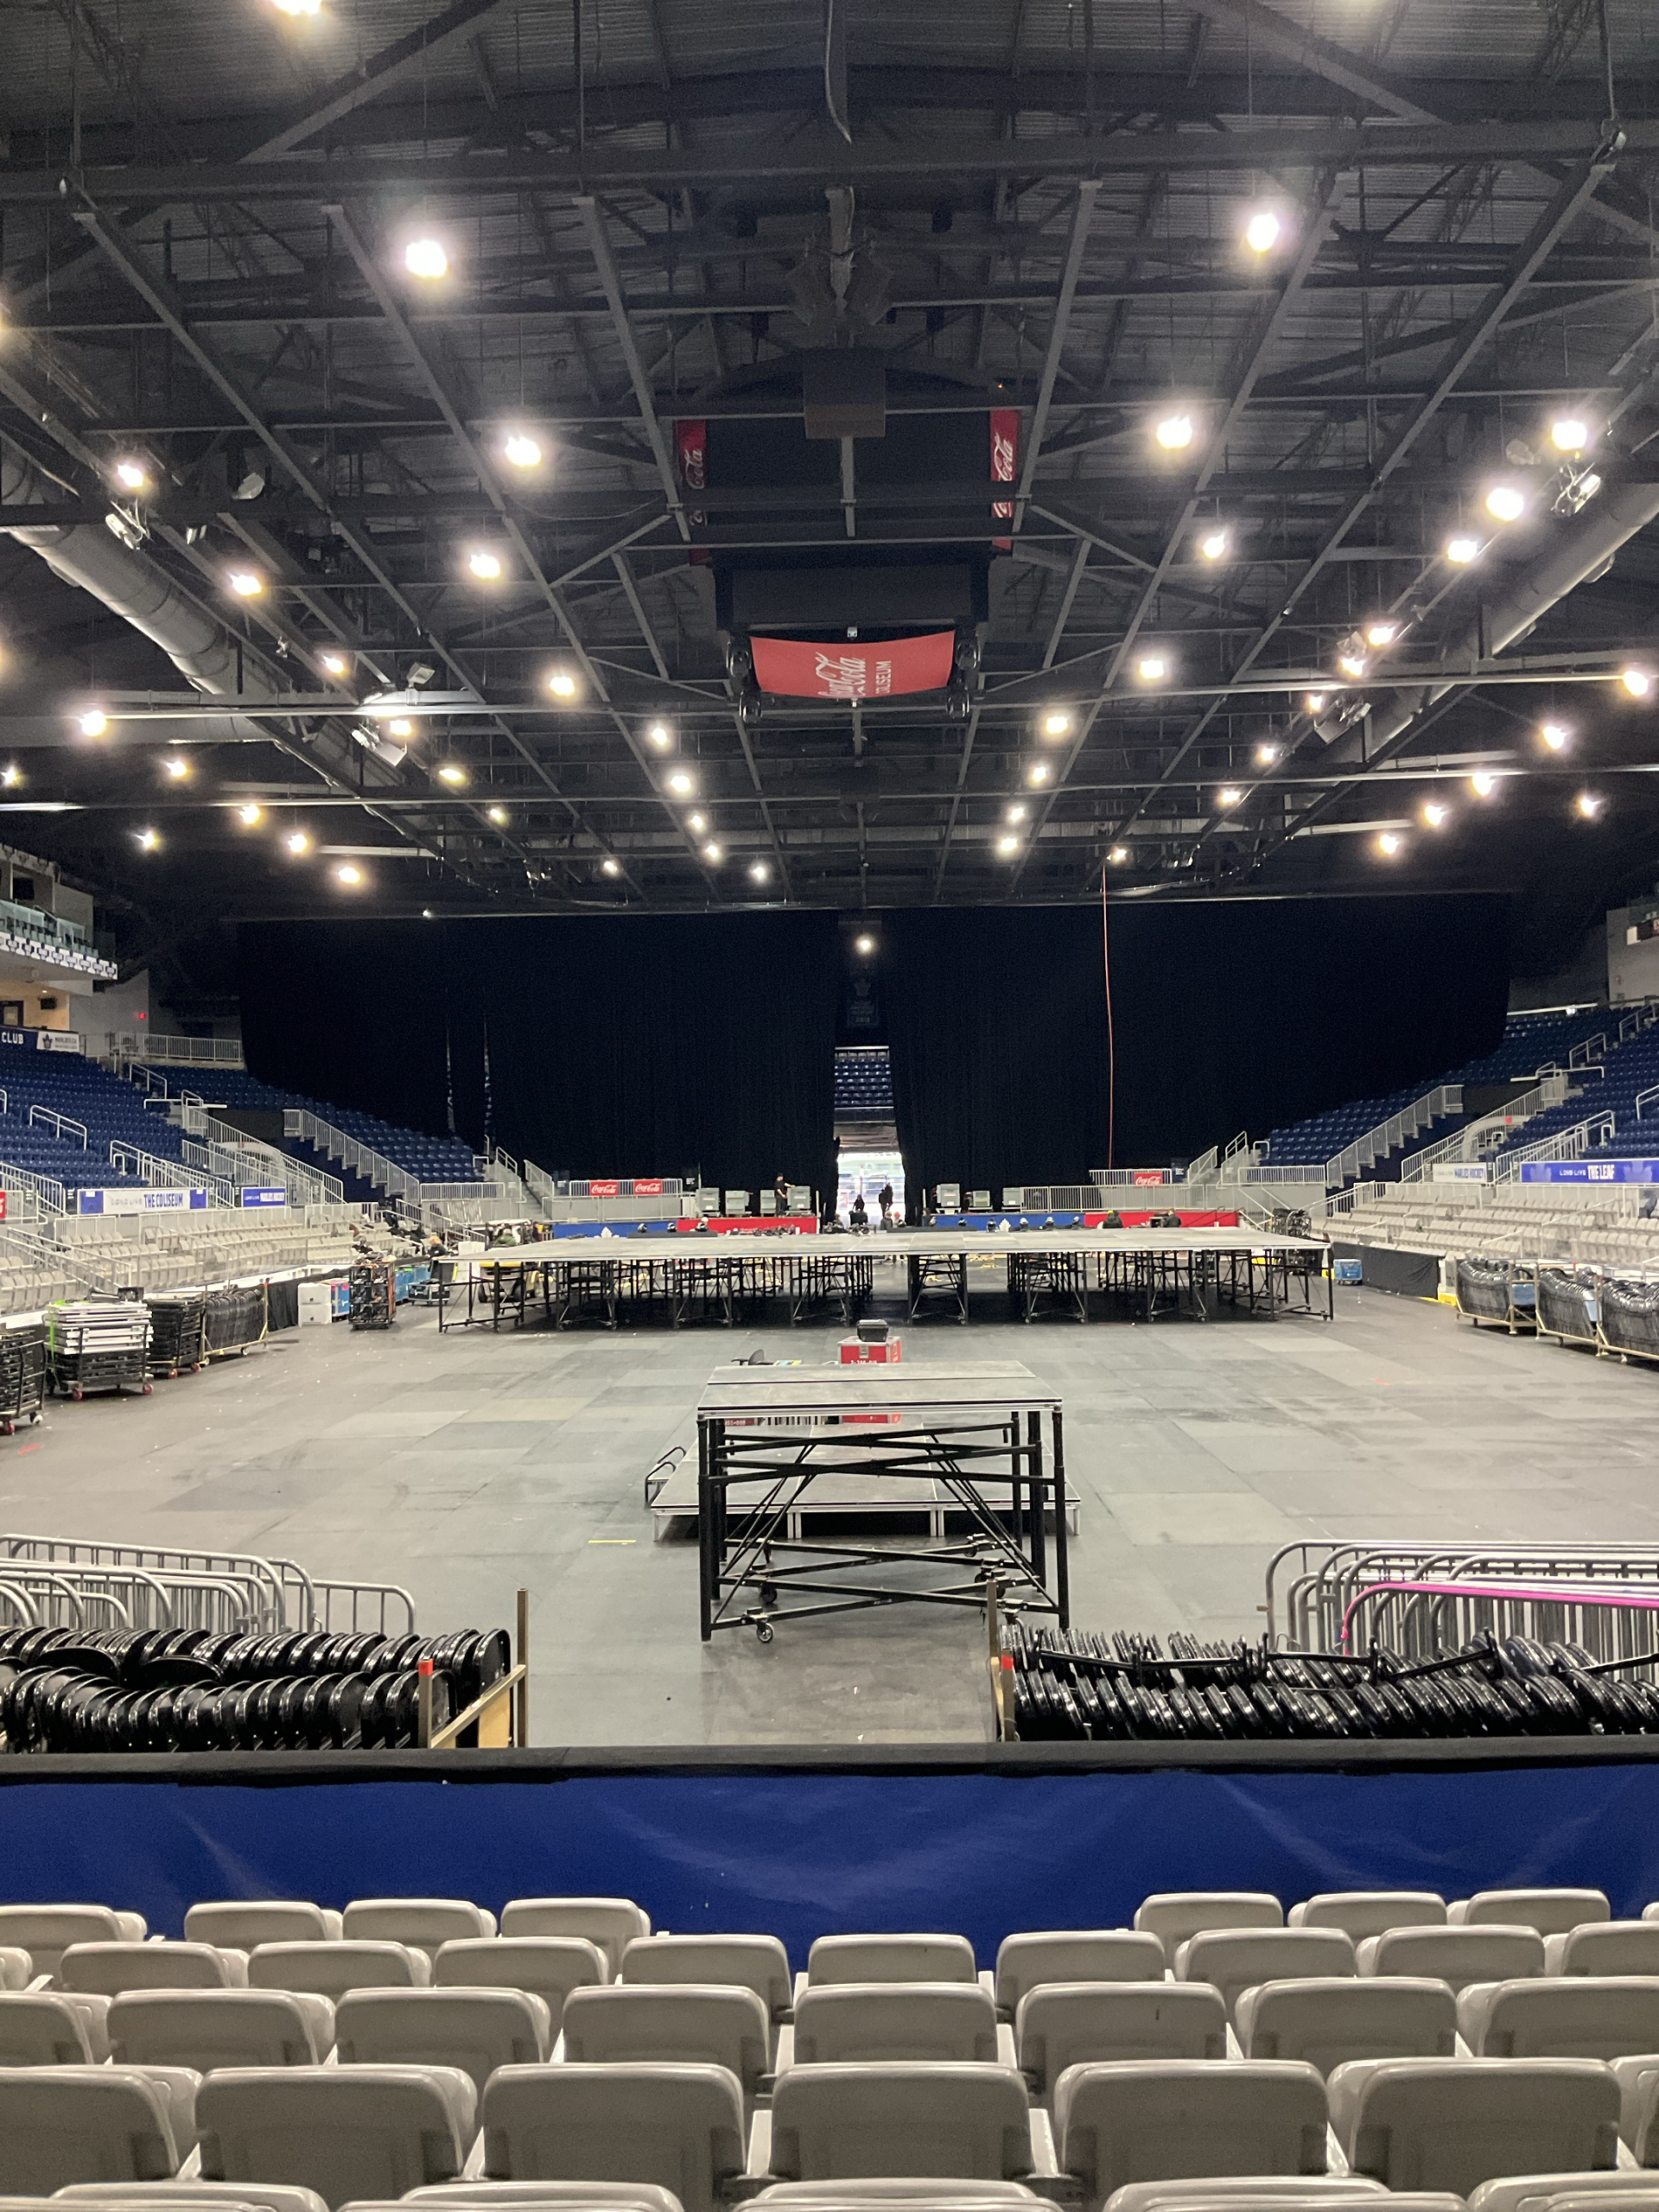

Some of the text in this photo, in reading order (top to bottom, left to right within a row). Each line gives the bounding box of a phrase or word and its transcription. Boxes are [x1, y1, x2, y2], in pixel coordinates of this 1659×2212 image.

[2, 1032, 24, 1045] CLUB
[1135, 1176, 1161, 1186] Coca-Cola
[591, 1184, 617, 1194] Coca-Cola
[634, 1183, 661, 1192] Coca-Cola
[143, 1194, 156, 1208] THE
[156, 1193, 184, 1207] COLISEUM
